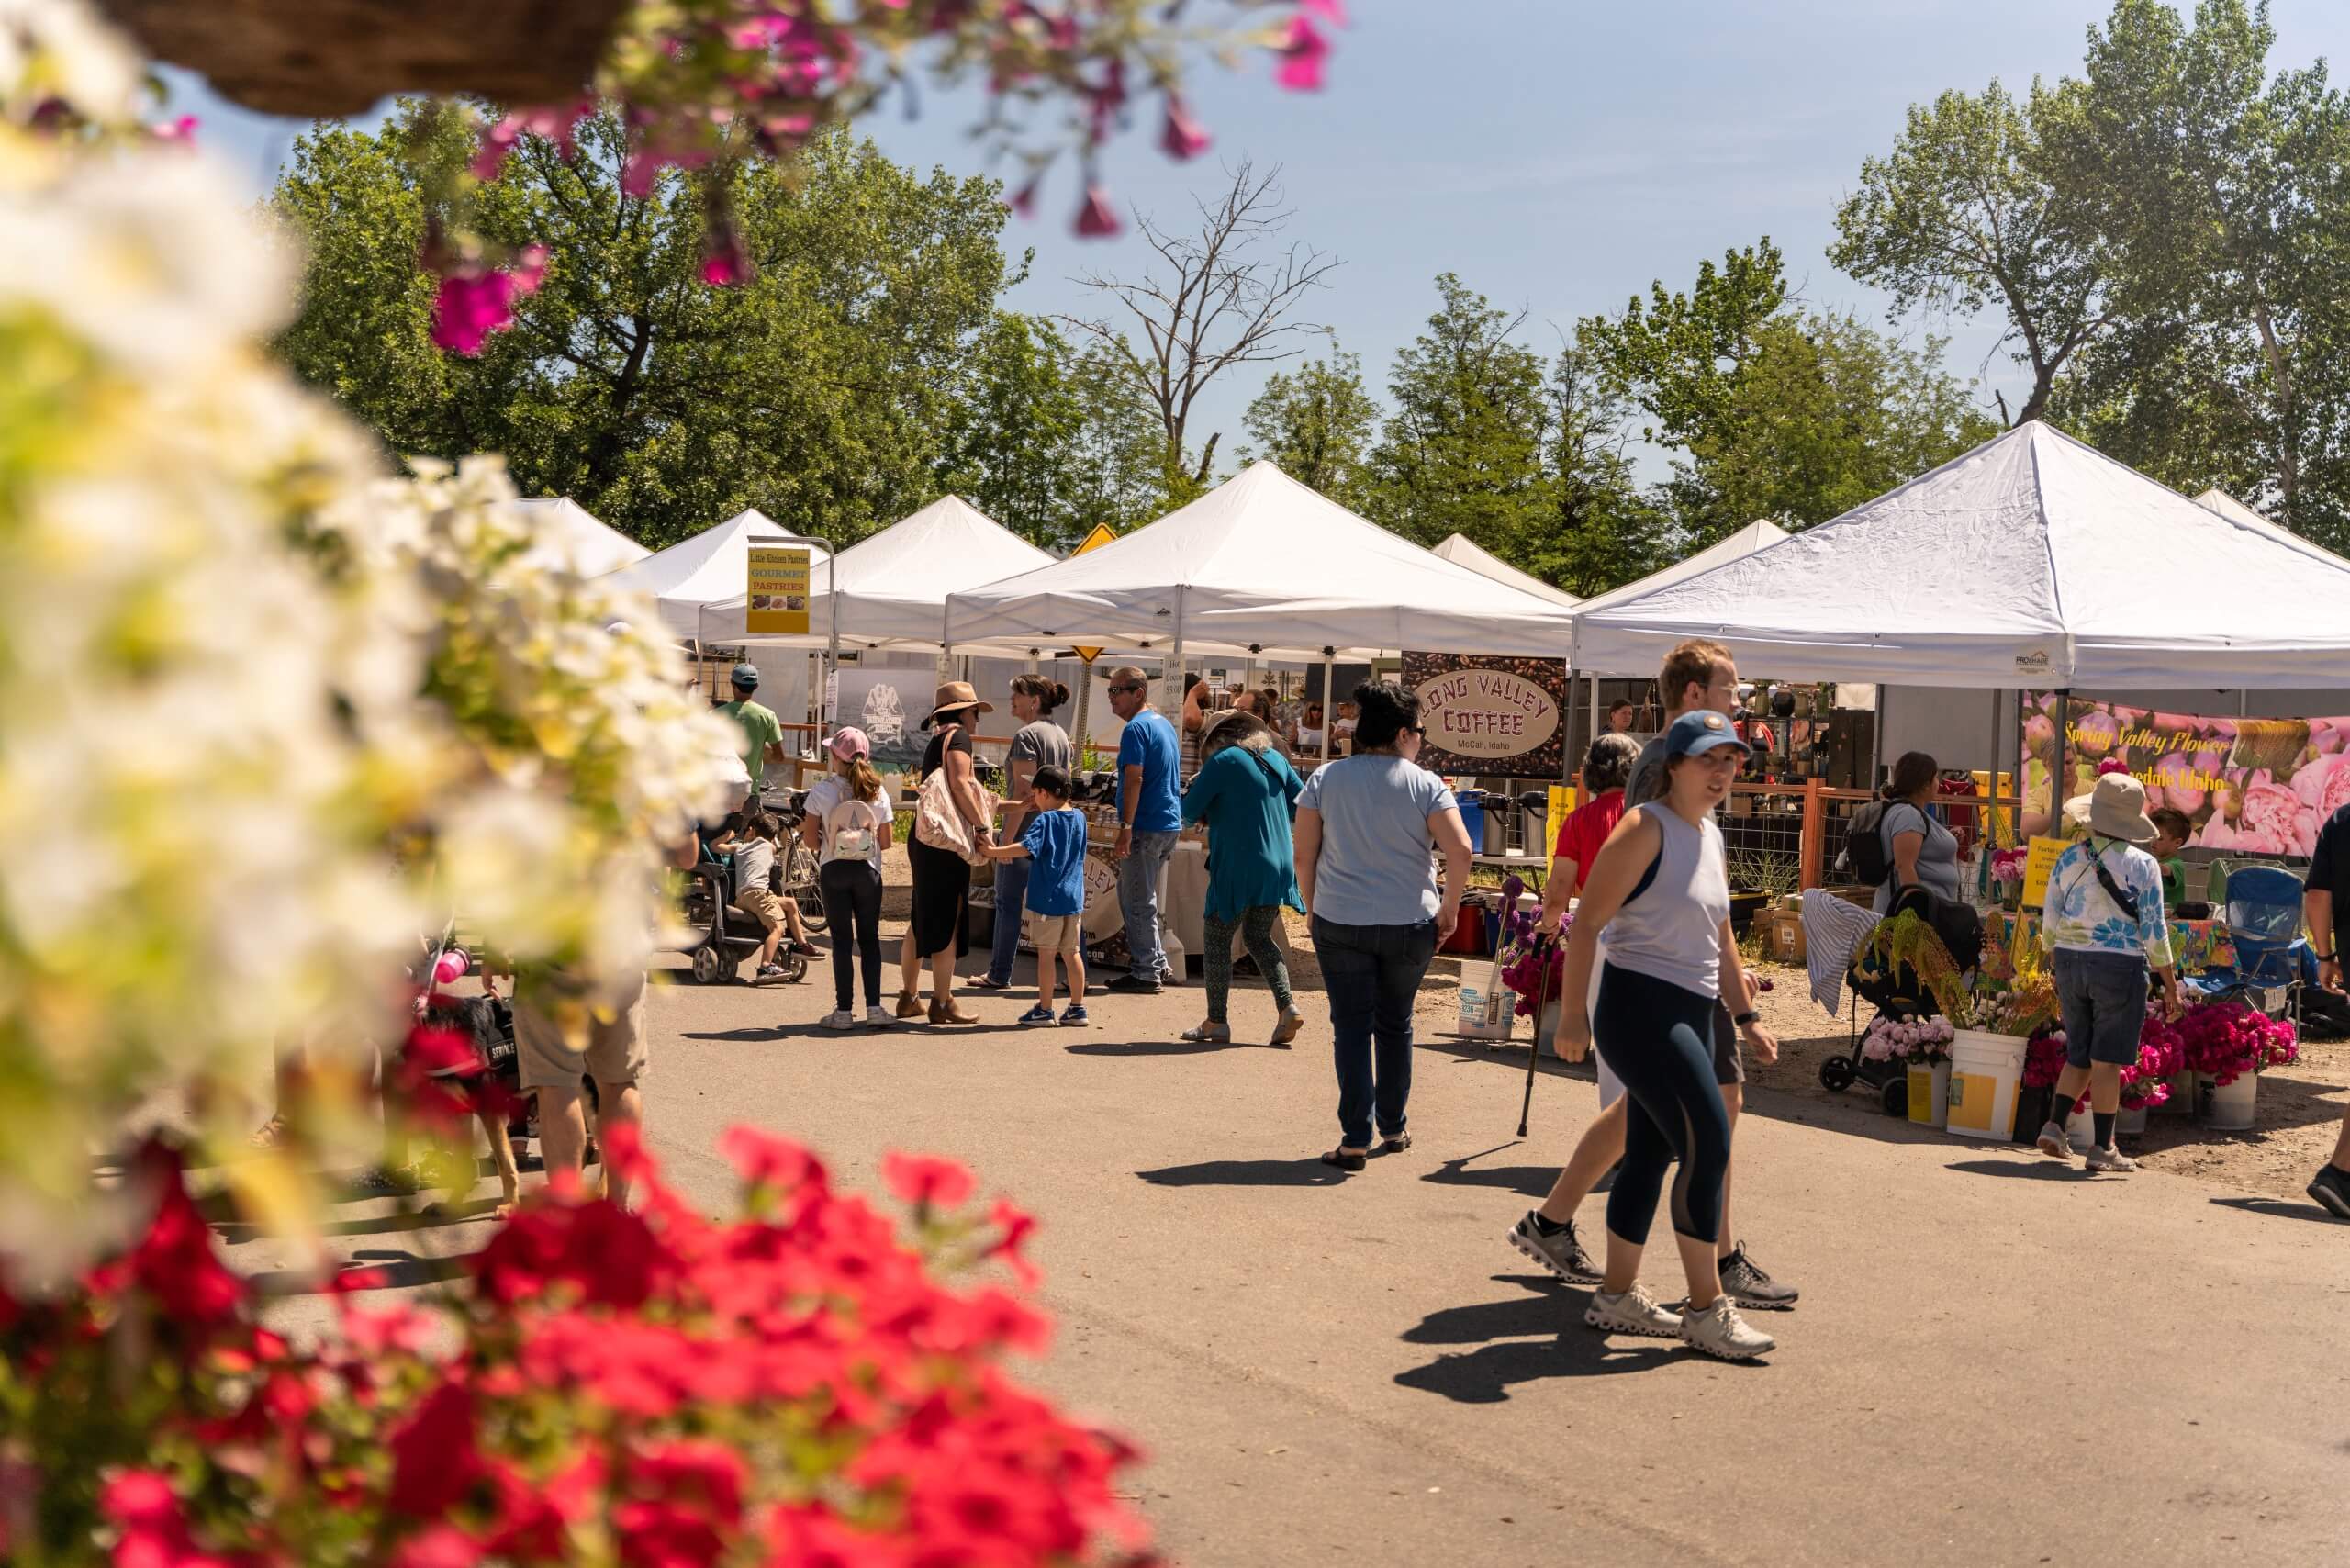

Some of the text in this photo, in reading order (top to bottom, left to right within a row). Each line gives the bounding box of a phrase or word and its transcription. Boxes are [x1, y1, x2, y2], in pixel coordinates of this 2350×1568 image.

[750, 554, 808, 564] Little Kitchen Pastries
[752, 569, 805, 577] GOURMET
[753, 582, 804, 590] PASTRIES
[1419, 675, 1550, 718] LONG VALLEY
[1443, 709, 1524, 735] COFFEE
[1489, 741, 1510, 750] Idaho
[2066, 720, 2115, 750] Spring
[2119, 727, 2166, 755] Valley
[2179, 768, 2225, 793] Idaho
